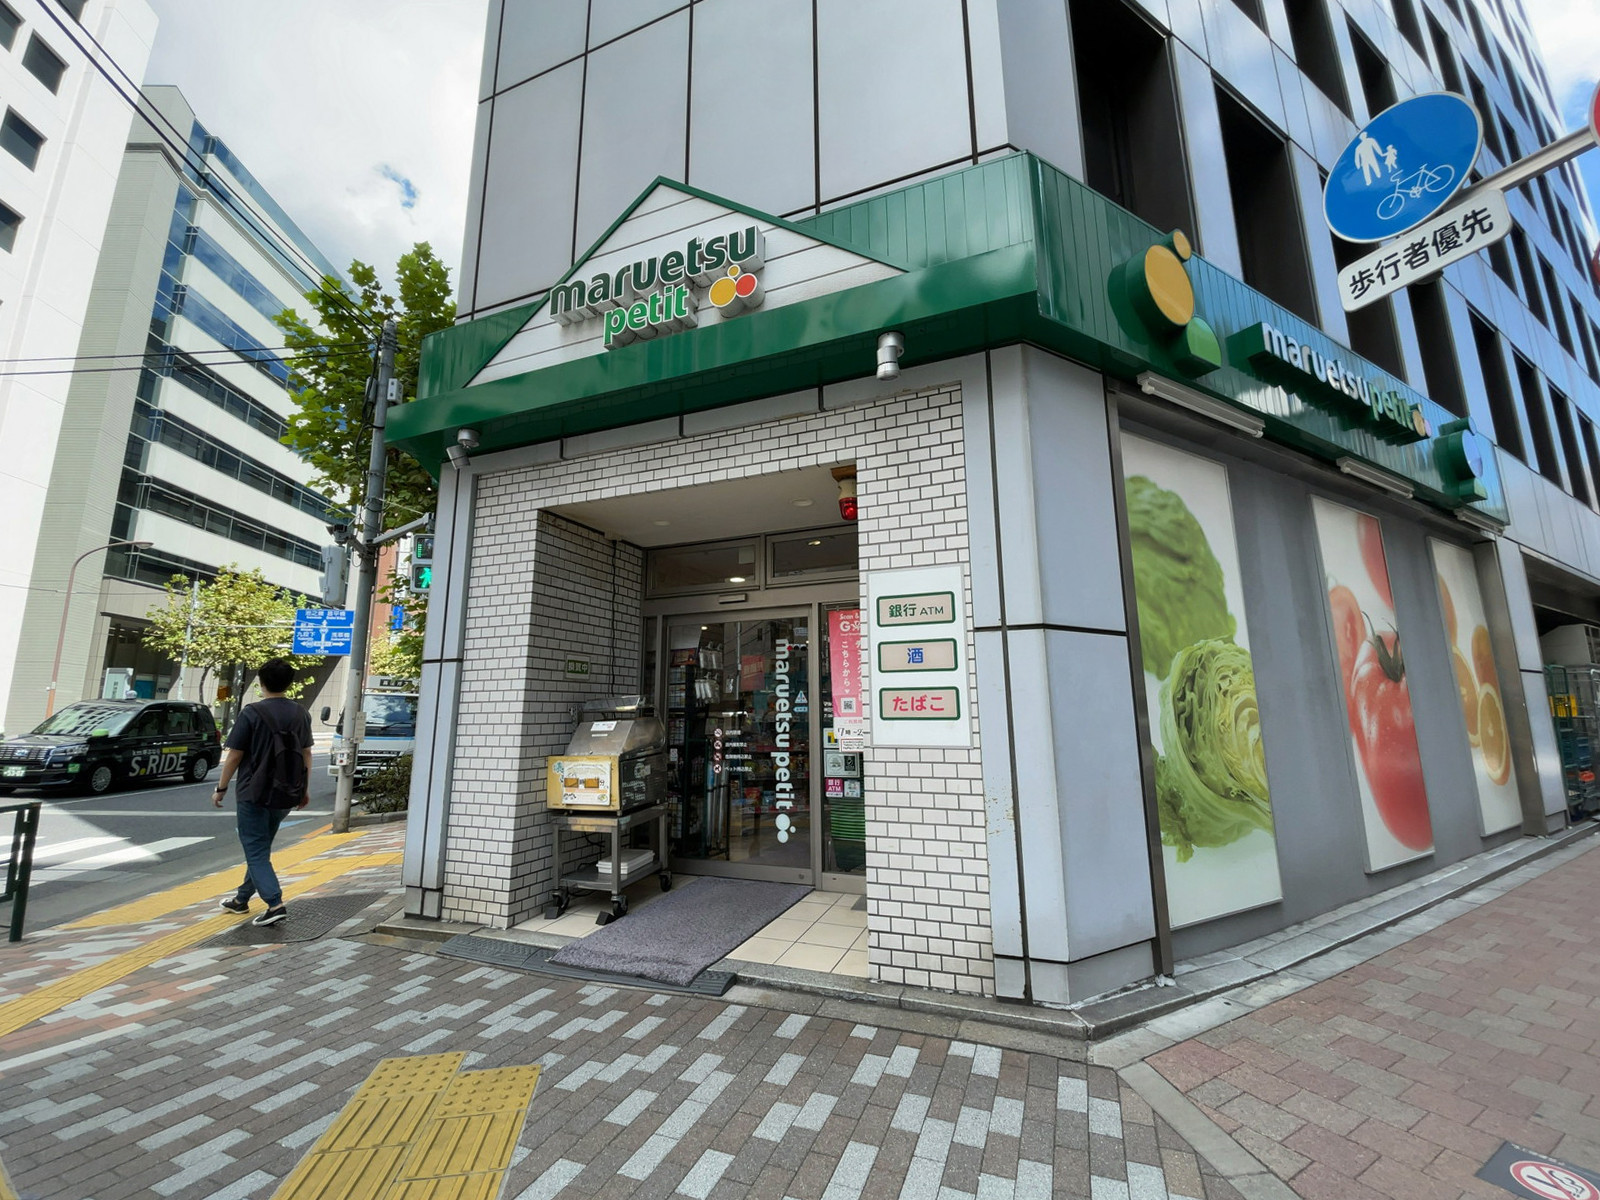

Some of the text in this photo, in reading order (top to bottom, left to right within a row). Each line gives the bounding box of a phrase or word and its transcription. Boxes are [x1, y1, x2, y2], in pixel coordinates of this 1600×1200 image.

[550, 225, 758, 318] maruetsu
[1349, 207, 1494, 300] 歩行者優先
[603, 283, 689, 346] petit
[1263, 322, 1371, 407] maruetsu
[888, 603, 944, 618] 銀行 ATM
[841, 641, 851, 687] こちらから
[907, 647, 924, 664] 酒
[771, 638, 795, 810] maruetsu petit
[892, 694, 945, 712] たばこ
[128, 752, 188, 777] S.RIDE
